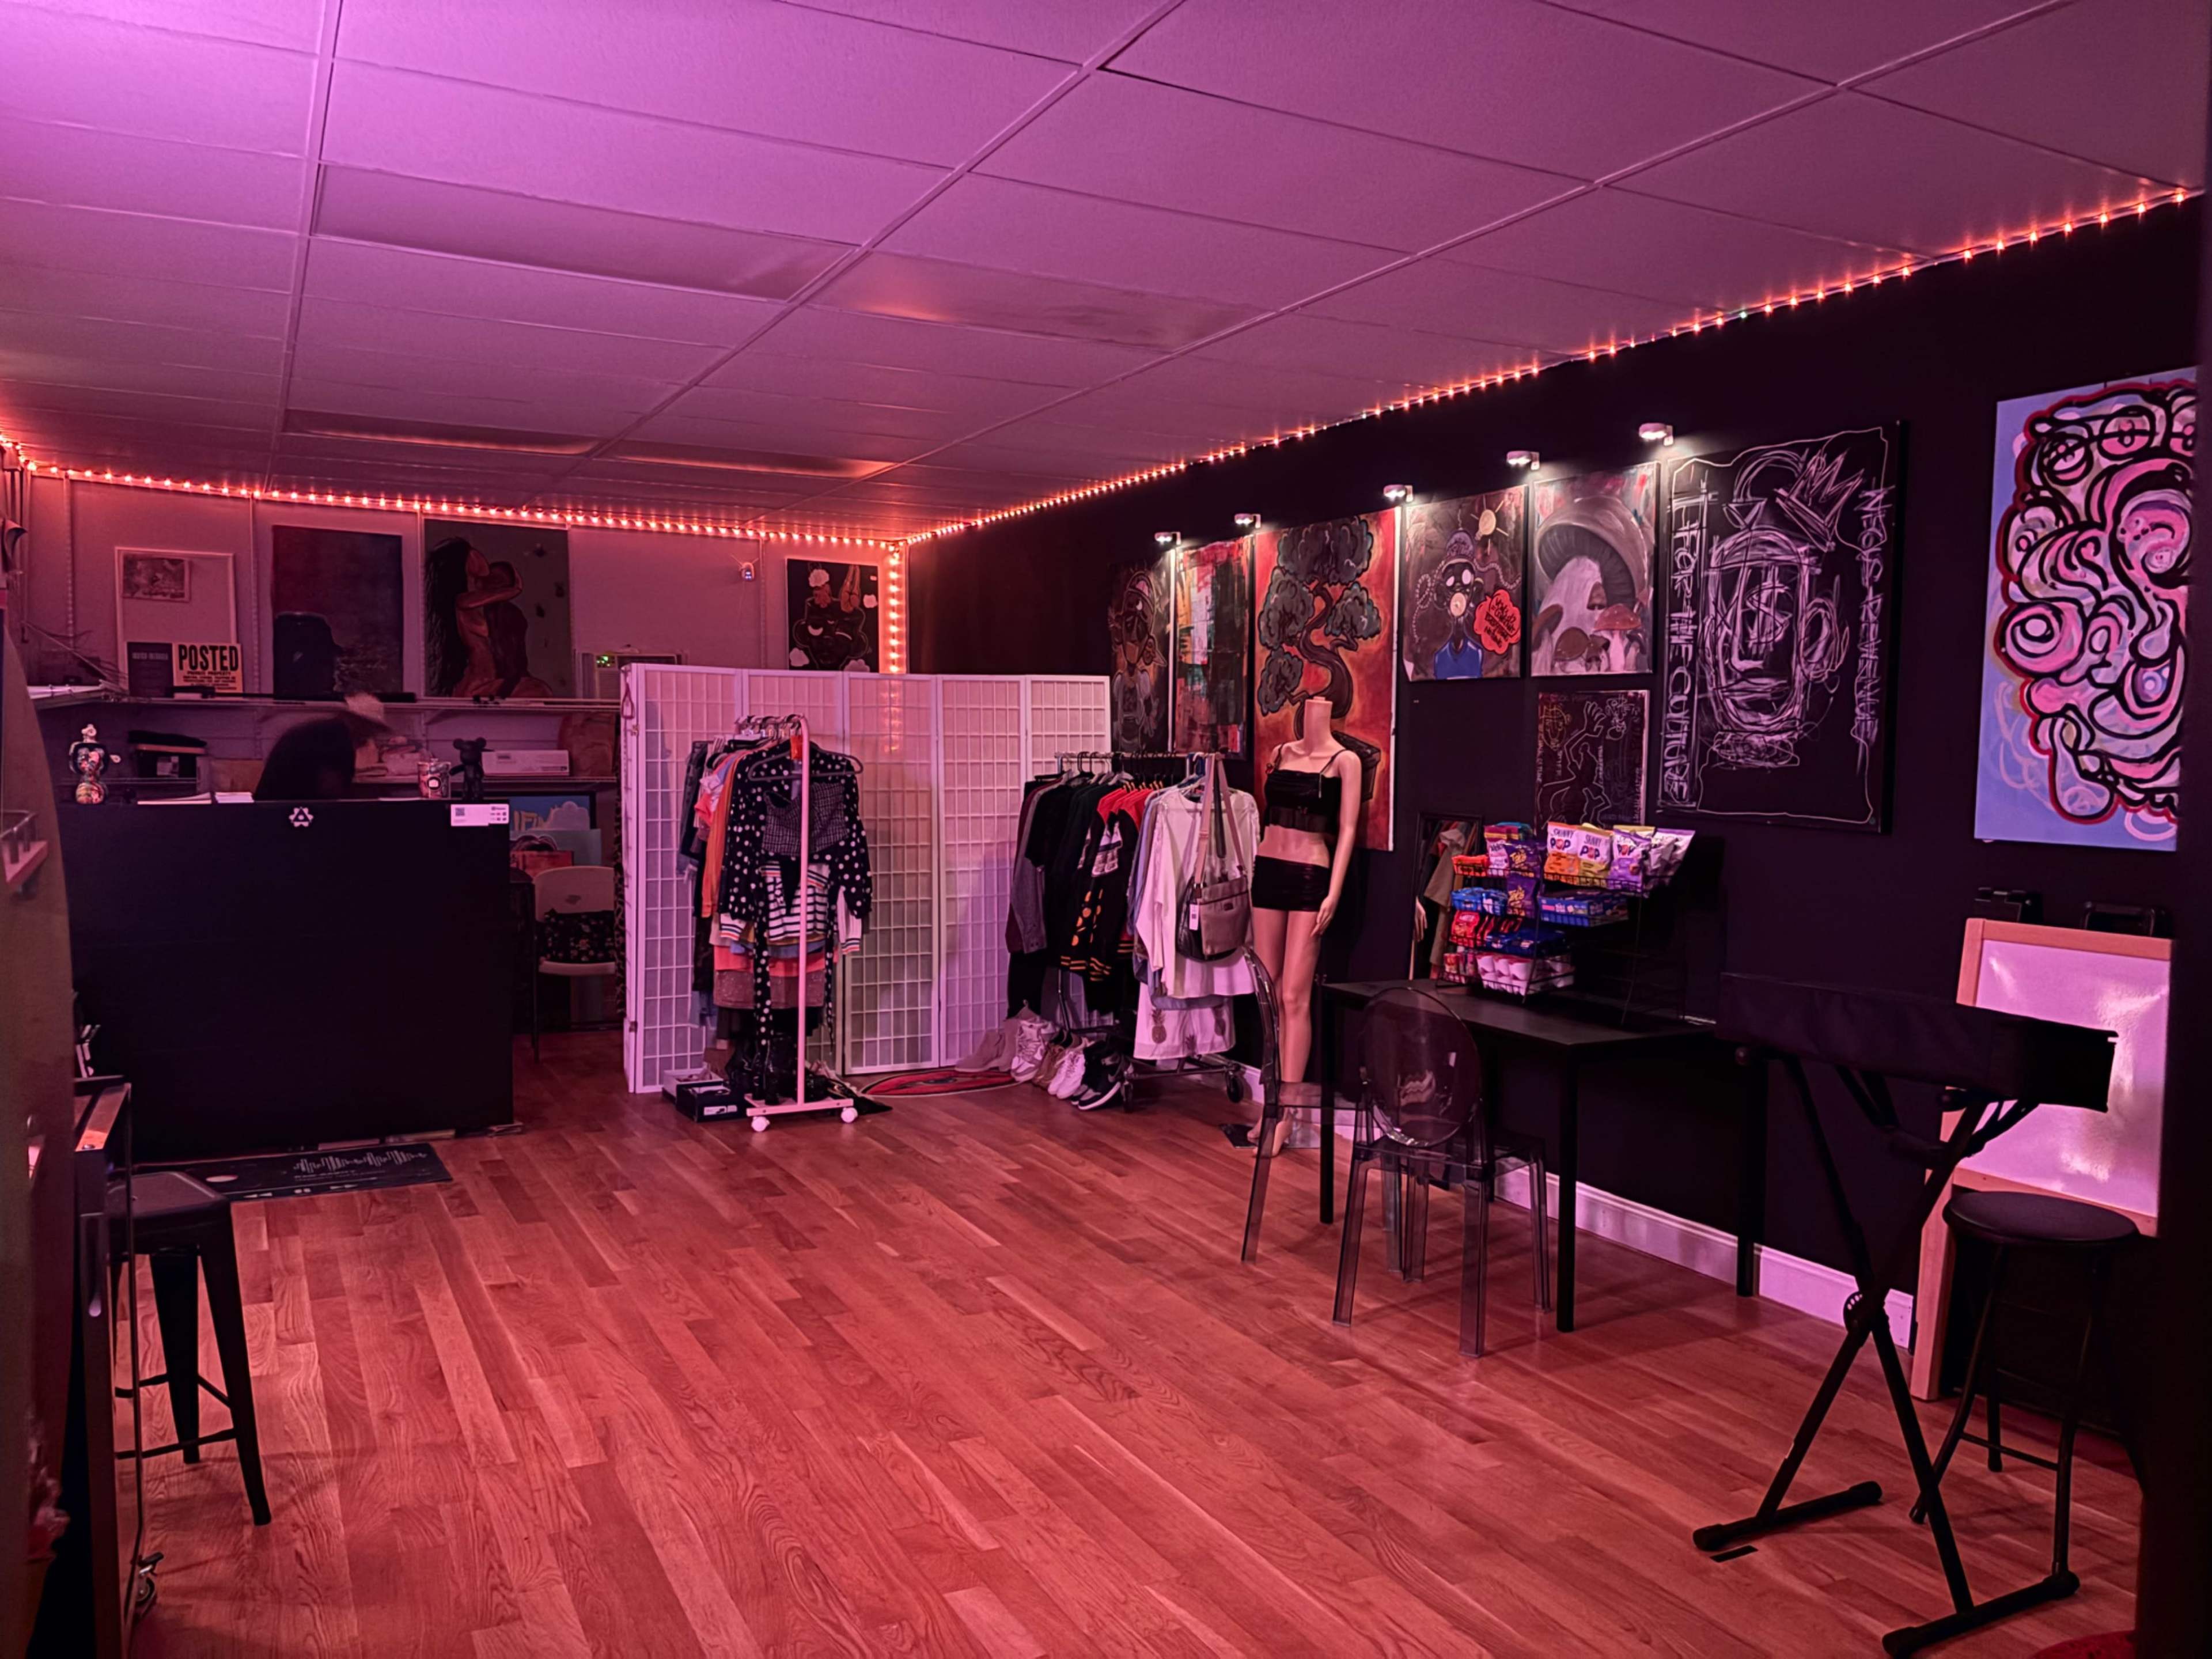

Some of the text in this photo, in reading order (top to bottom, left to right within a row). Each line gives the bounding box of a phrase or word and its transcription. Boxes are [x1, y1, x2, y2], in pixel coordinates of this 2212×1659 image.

[178, 644, 239, 671] POSTED
[1550, 839, 1571, 850] POP
[1580, 845, 1600, 860] POP
